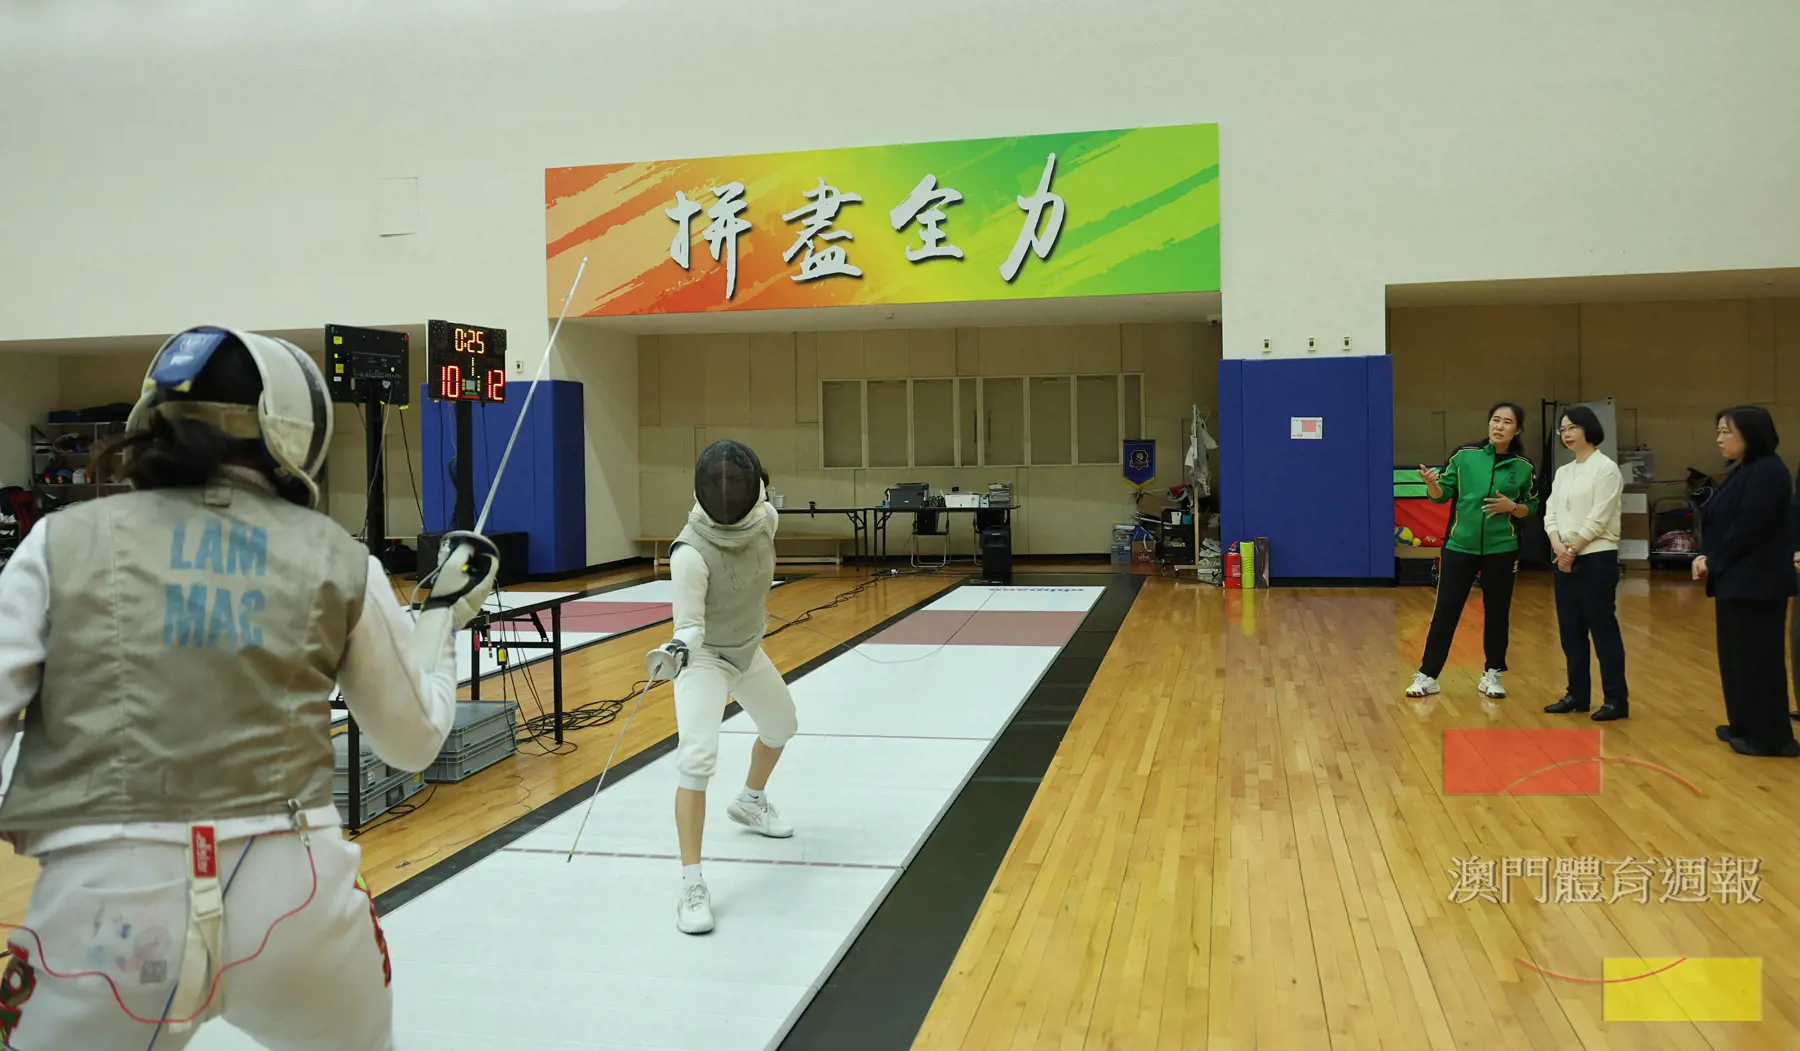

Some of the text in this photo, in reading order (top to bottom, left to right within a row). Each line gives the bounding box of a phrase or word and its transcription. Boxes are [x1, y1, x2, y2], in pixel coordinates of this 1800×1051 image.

[664, 152, 1067, 301] 拼盡全力
[454, 328, 485, 354] 0:25
[441, 365, 459, 398] 10
[488, 369, 504, 400] 12
[170, 516, 268, 577] LAM
[161, 583, 266, 652] MAC
